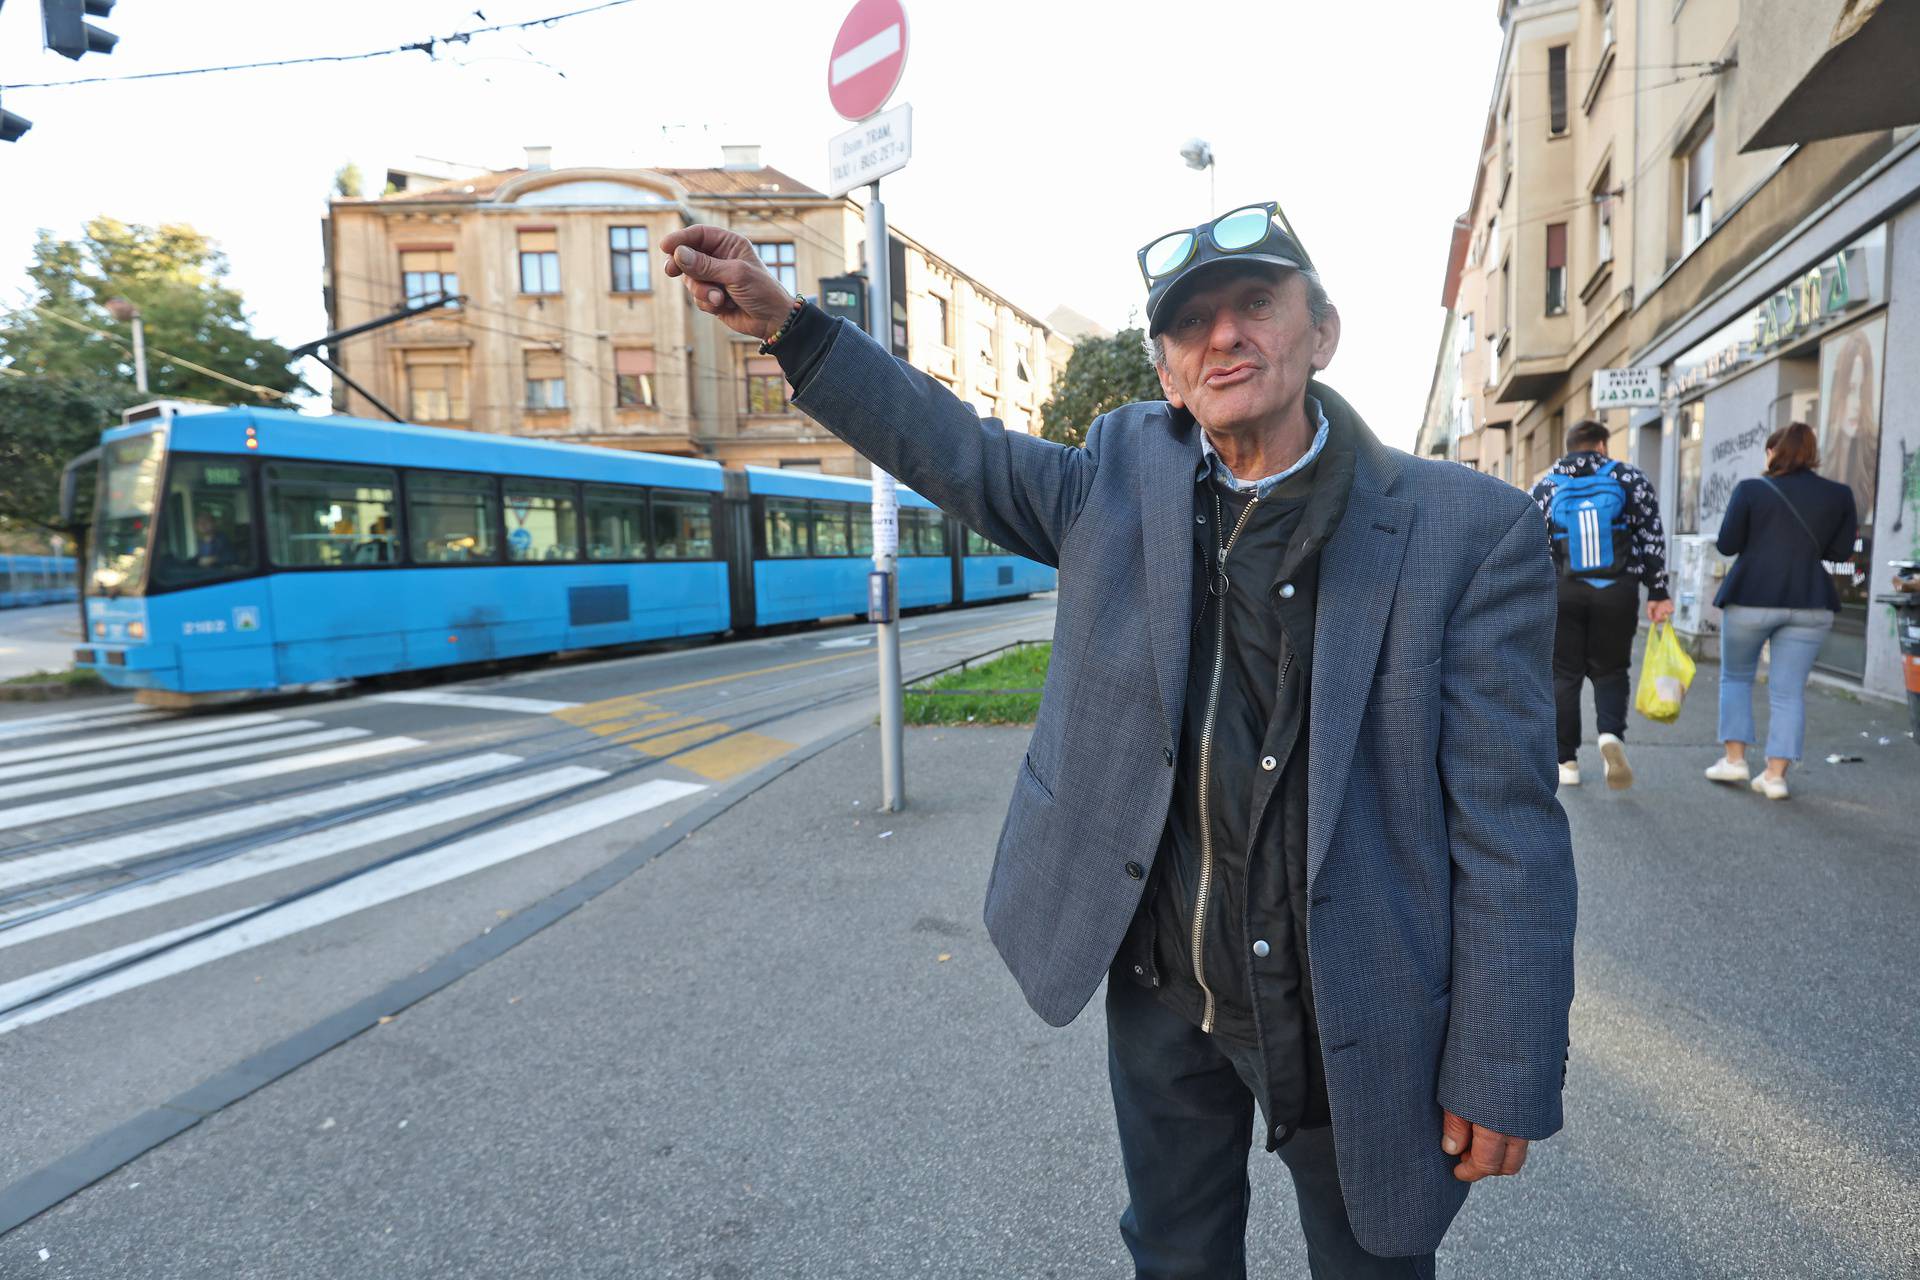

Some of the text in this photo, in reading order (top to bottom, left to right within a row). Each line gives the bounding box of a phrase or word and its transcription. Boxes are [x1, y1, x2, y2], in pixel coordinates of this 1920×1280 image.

[866, 123, 890, 146] TRAM
[861, 149, 877, 170] BUS
[1600, 387, 1655, 401] JASNA
